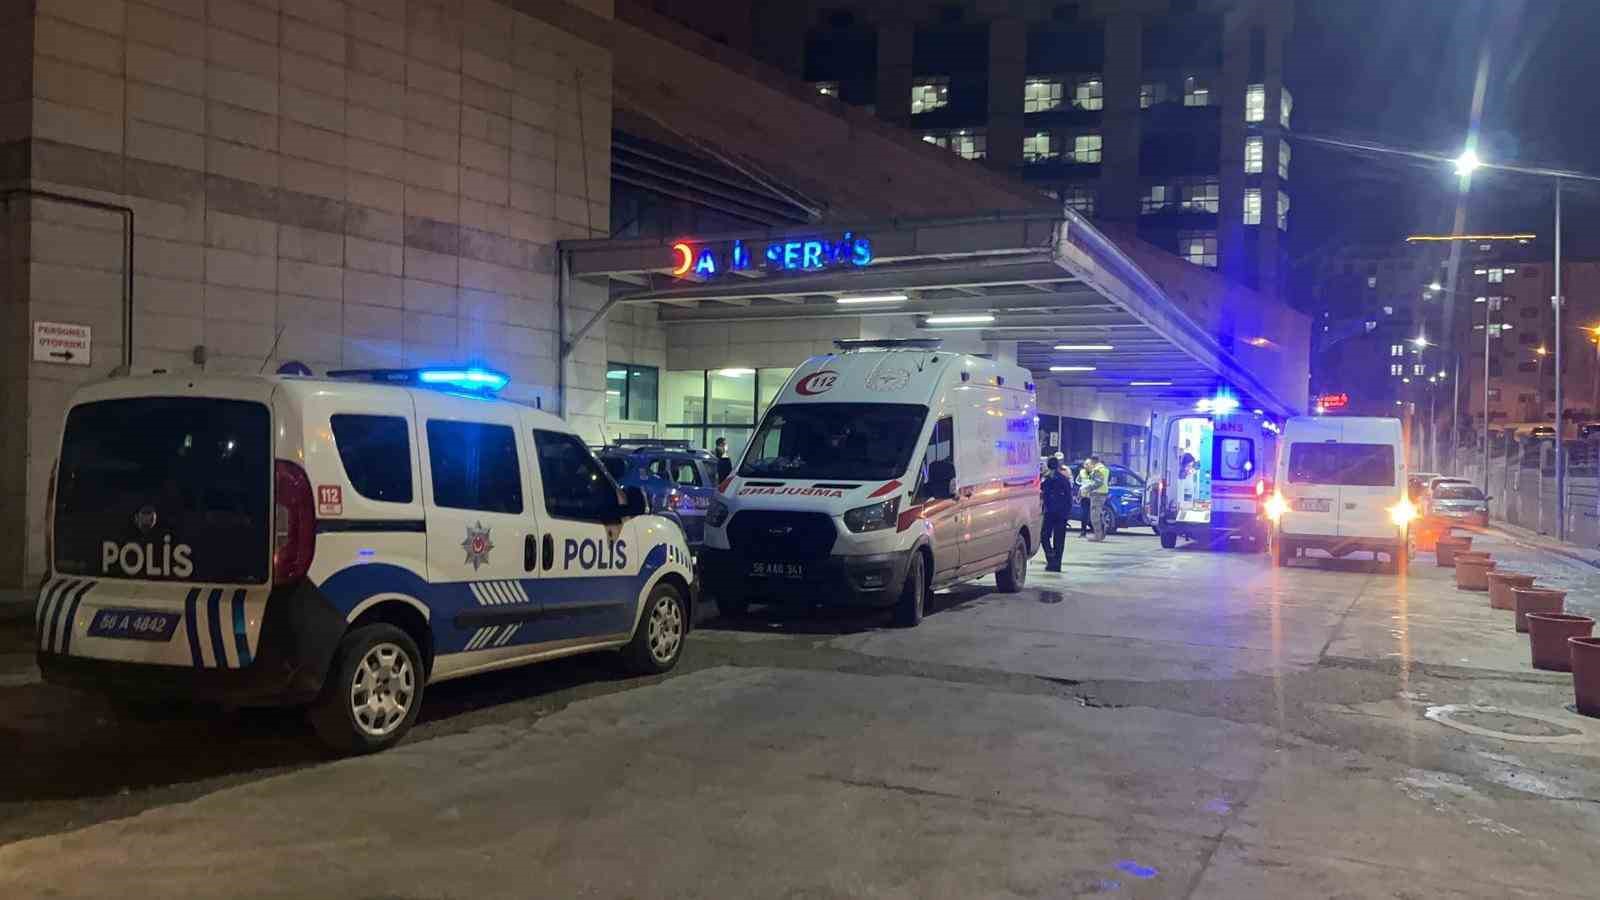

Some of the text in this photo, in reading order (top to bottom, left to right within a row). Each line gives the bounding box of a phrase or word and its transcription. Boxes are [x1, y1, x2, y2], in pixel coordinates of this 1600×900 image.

[812, 376, 837, 388] 112
[320, 487, 339, 503] 112
[102, 534, 193, 577] POLİS
[118, 615, 130, 630] A
